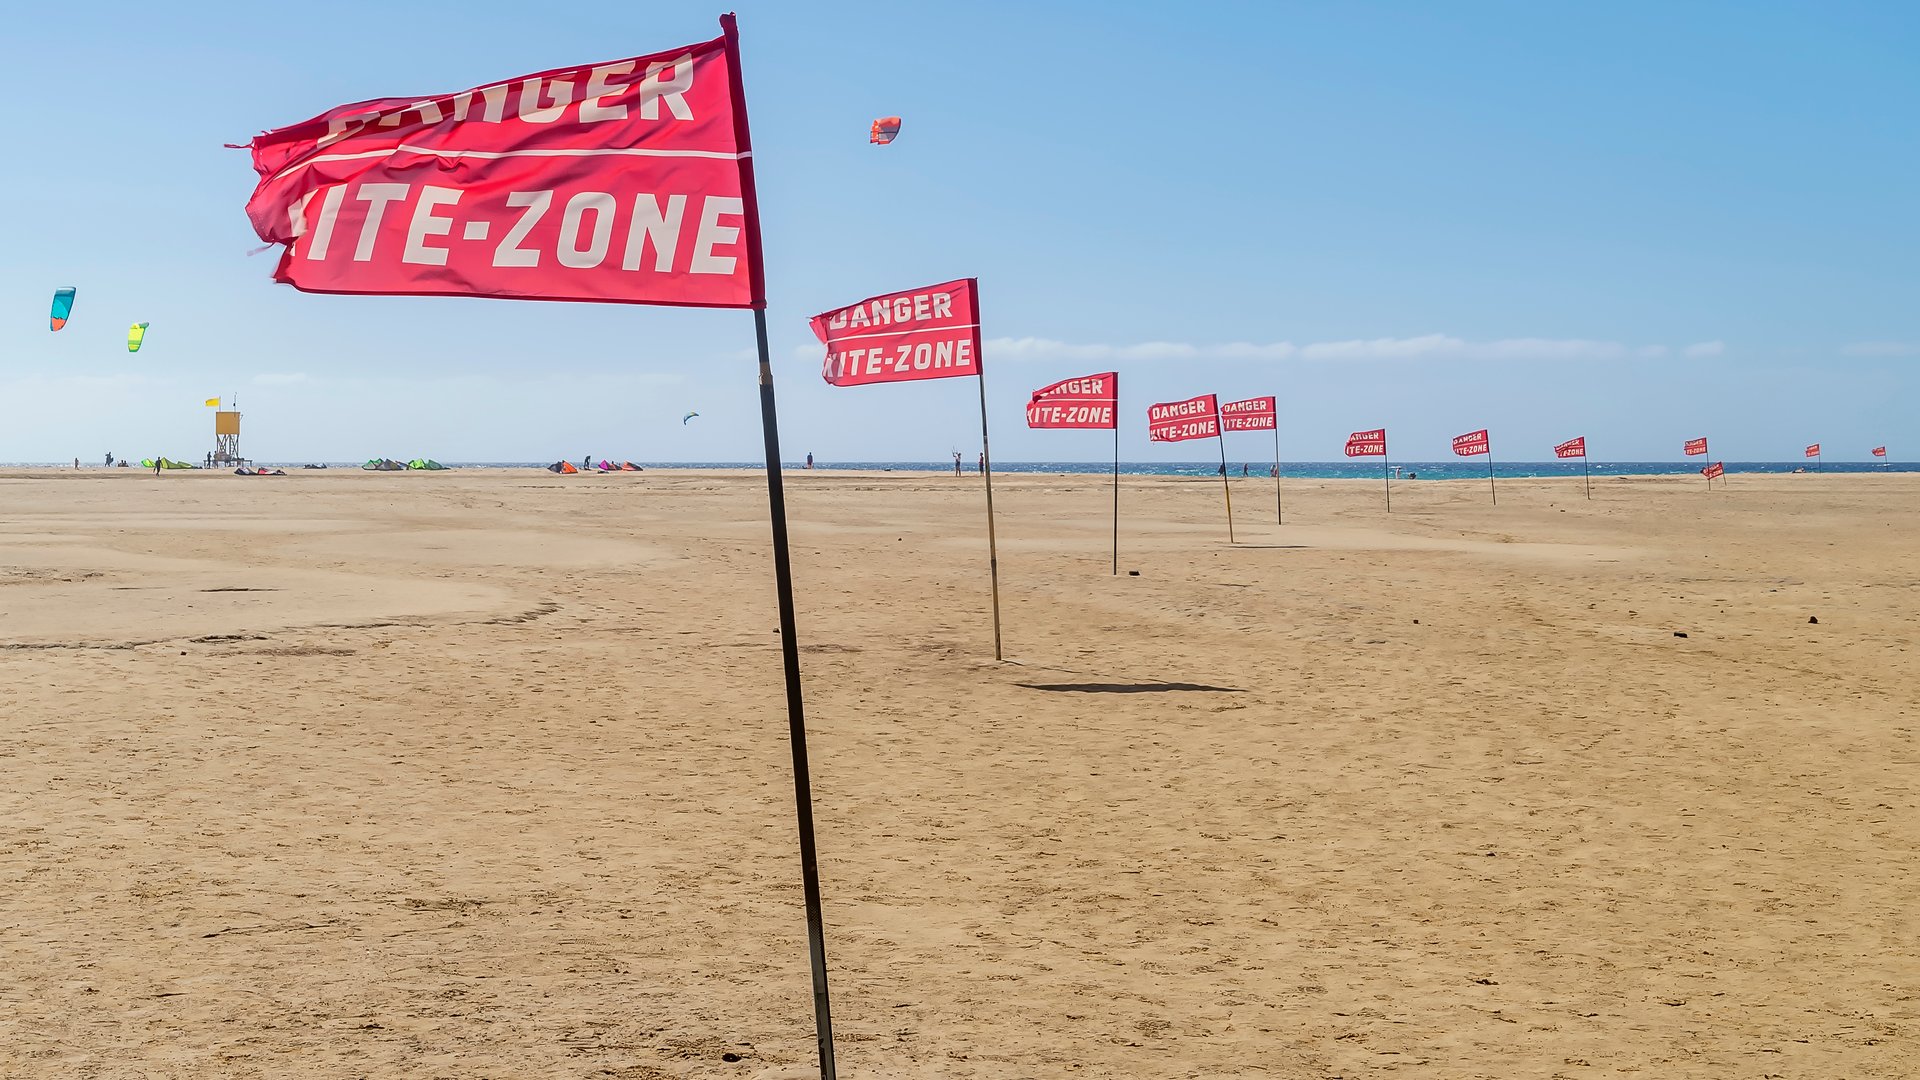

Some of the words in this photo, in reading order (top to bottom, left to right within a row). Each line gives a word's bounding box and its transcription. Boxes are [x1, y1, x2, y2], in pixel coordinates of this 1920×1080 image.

[829, 292, 953, 330] DANGER
[1152, 400, 1206, 420] DANGER
[1224, 400, 1267, 412] DANGER
